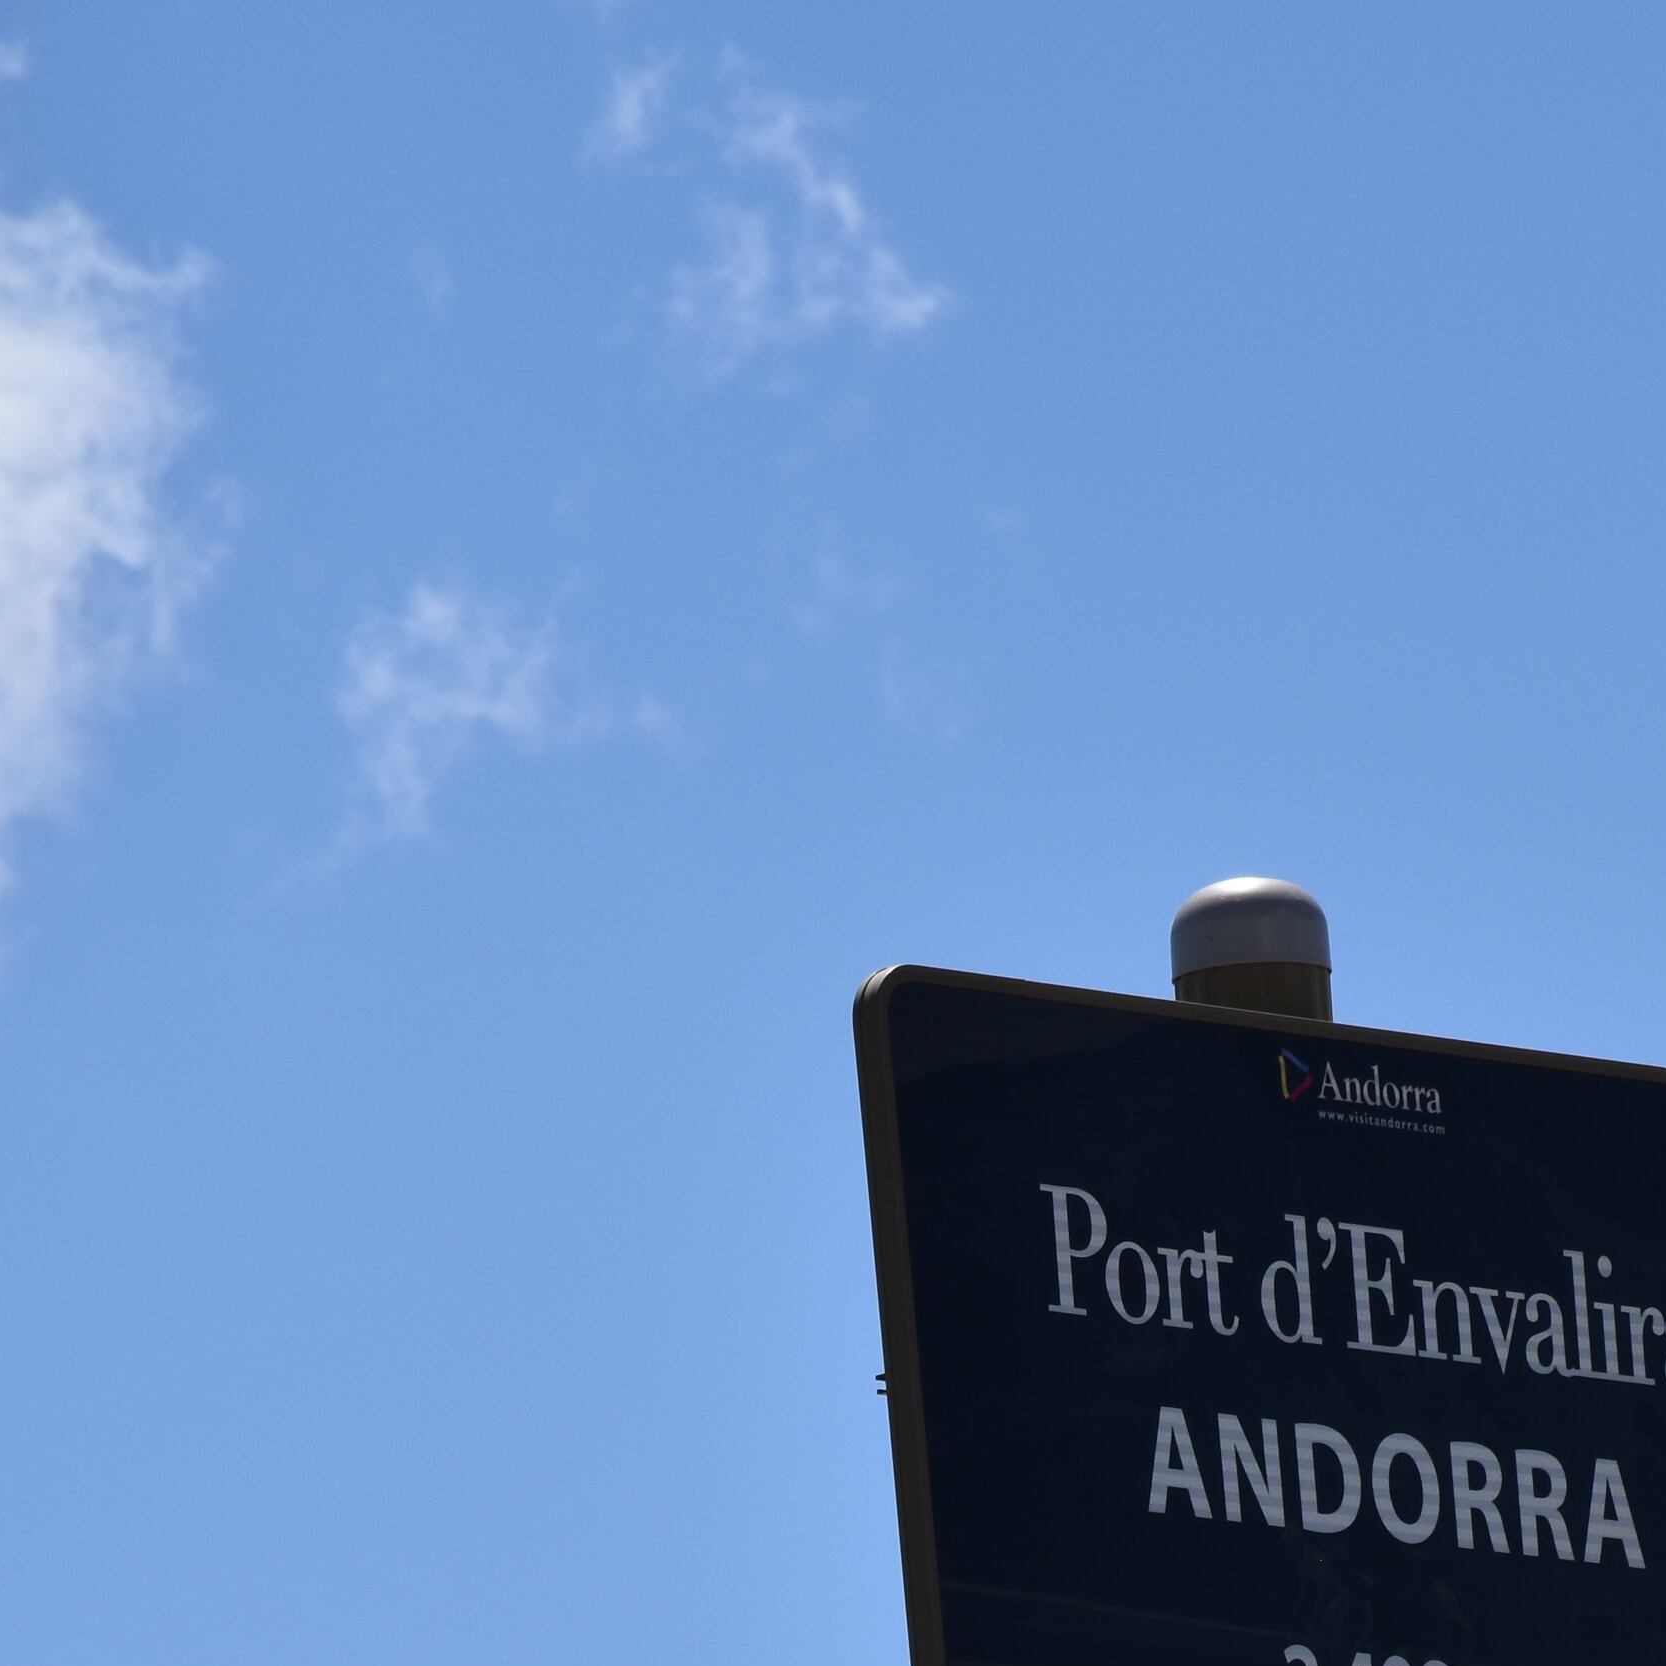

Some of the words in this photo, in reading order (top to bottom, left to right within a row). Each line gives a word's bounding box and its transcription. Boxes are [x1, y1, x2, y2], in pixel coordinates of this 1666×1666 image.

[1318, 1060, 1442, 1114] Andorra
[1318, 1109, 1445, 1135] www.visitandorra.com
[1039, 1183, 1239, 1338] Port
[1147, 1405, 1646, 1569] ANDORRA
